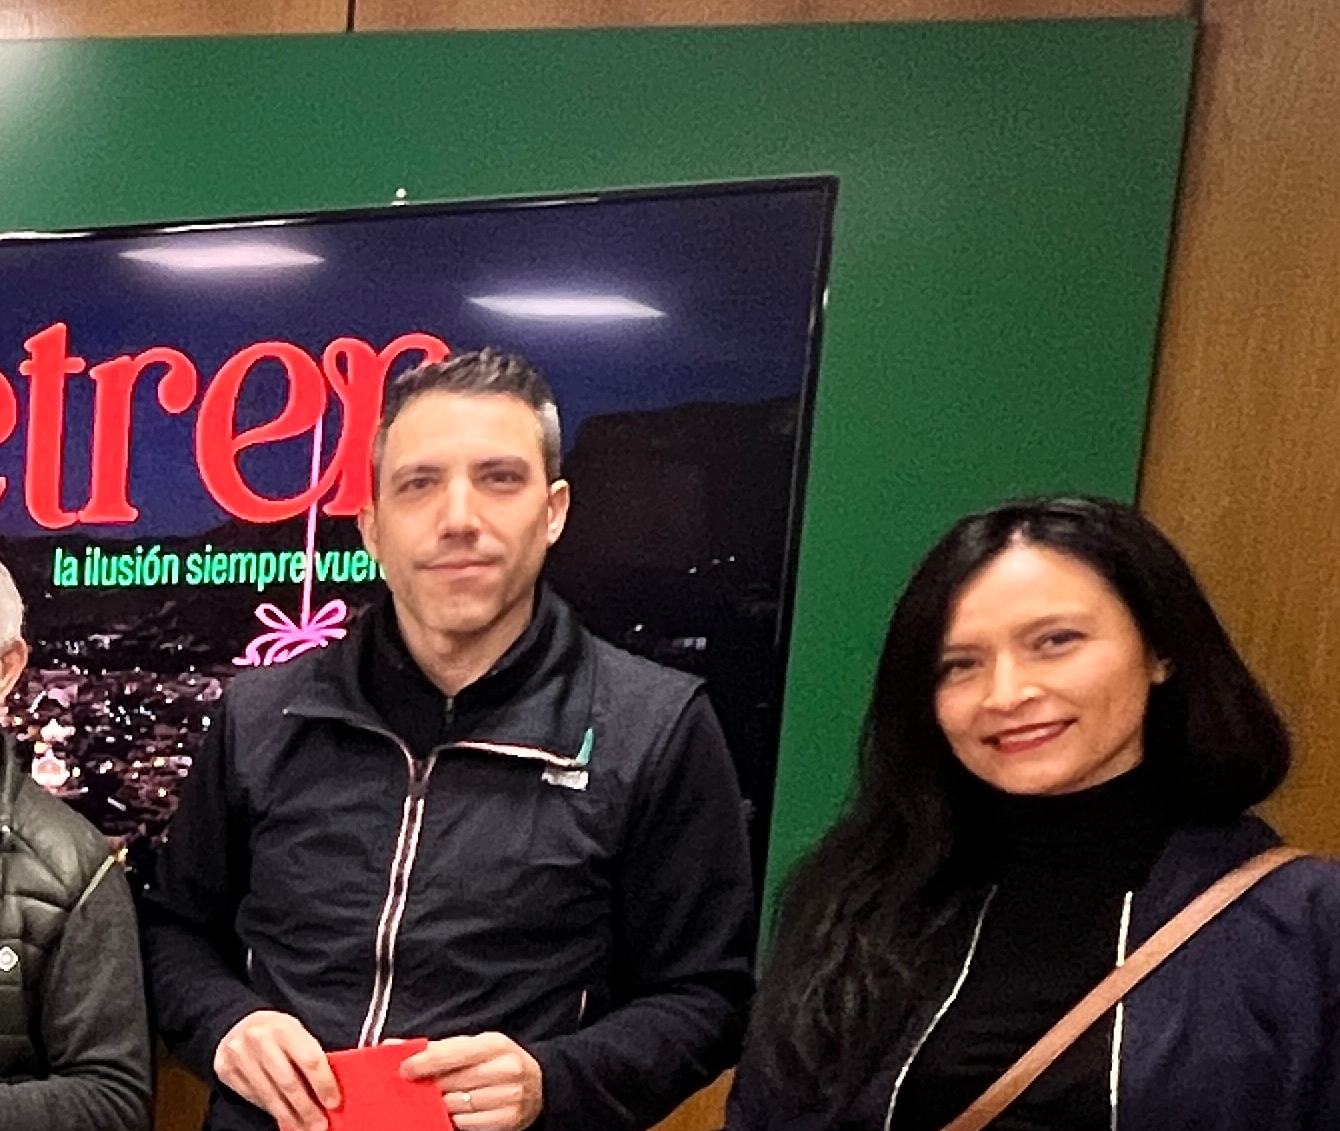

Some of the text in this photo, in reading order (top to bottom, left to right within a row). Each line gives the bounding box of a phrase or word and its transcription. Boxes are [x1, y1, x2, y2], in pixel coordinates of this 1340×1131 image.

[53, 547, 78, 586] la
[84, 545, 179, 586] ilusión
[186, 544, 306, 592] siempre
